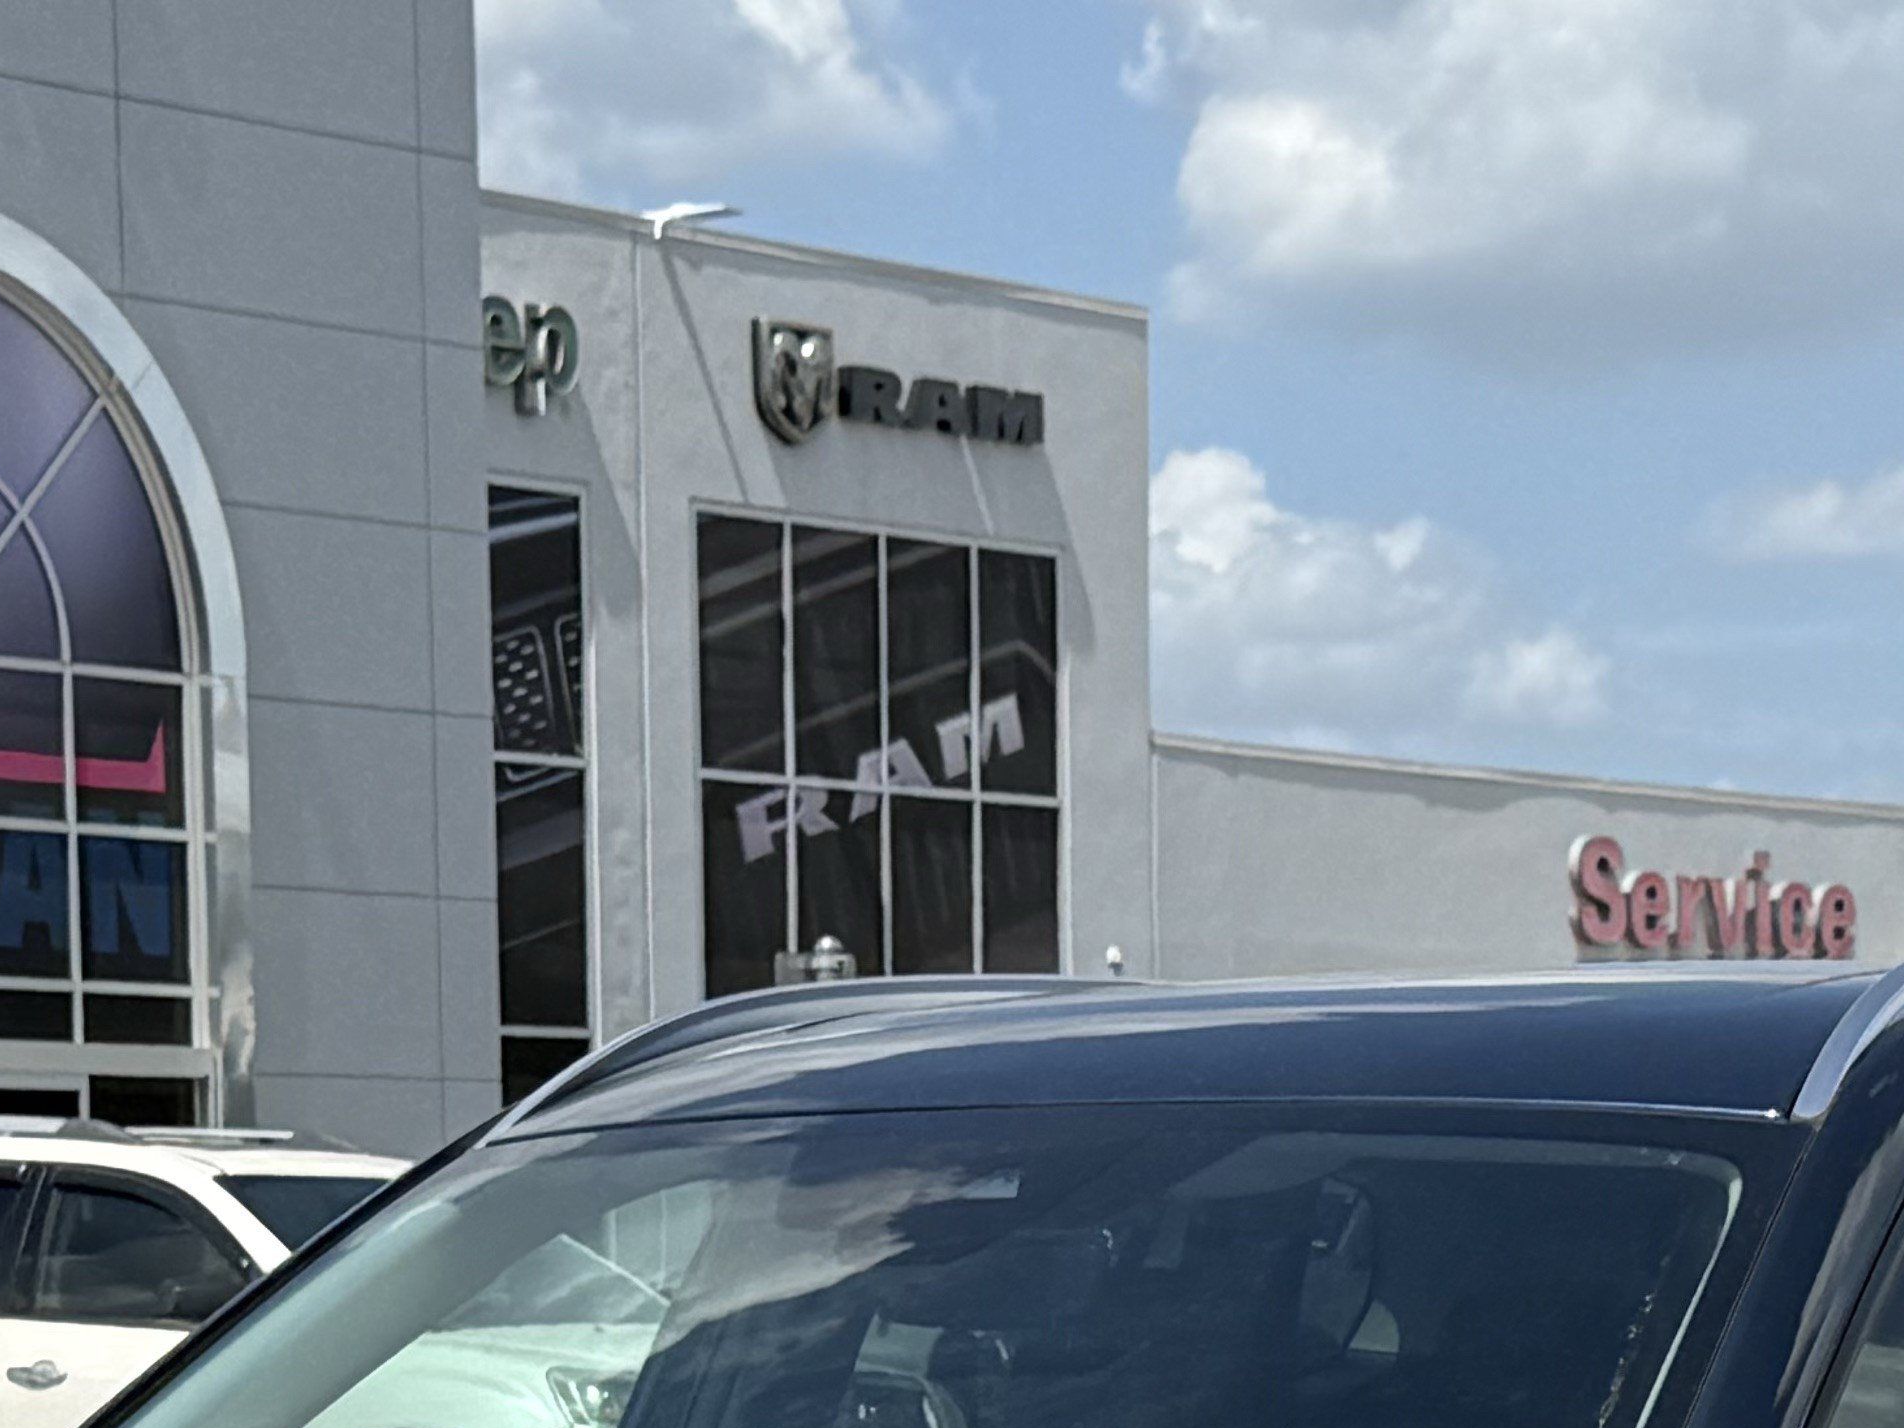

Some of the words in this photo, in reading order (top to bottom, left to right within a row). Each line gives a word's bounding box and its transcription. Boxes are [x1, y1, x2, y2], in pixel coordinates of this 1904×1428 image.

[482, 294, 579, 416] ep
[838, 365, 1045, 444] RAM
[734, 693, 1026, 865] RAM
[1569, 834, 1857, 959] Service
